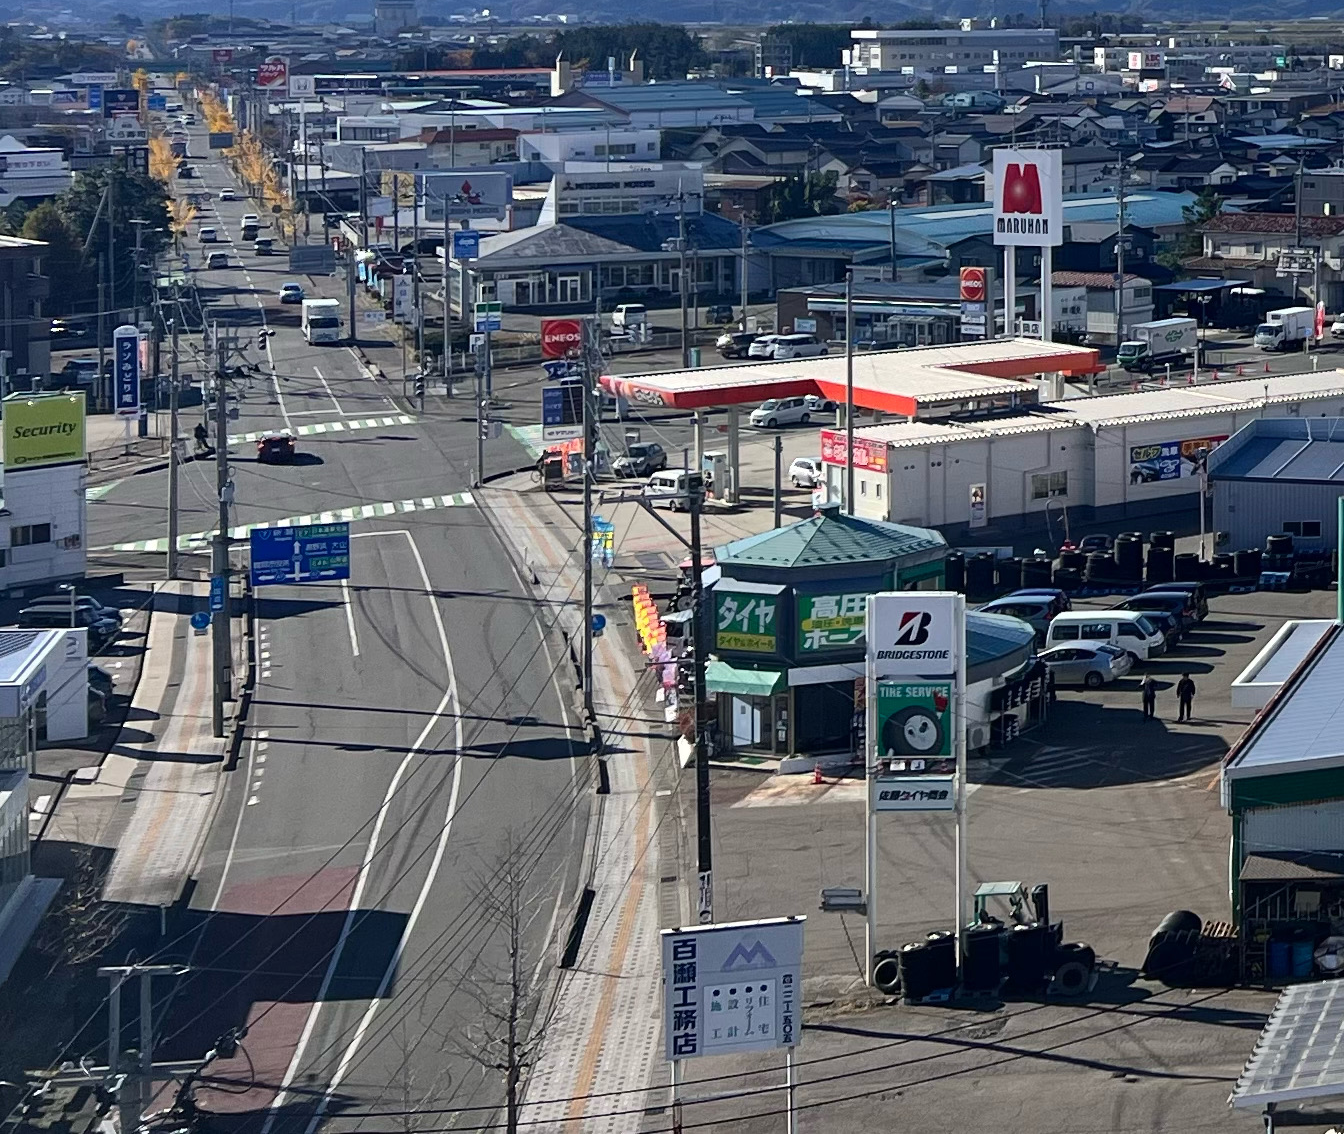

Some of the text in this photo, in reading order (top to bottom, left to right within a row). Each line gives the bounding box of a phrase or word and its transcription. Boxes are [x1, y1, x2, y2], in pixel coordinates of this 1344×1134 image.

[996, 217, 1049, 234] MARUHAN
[544, 333, 581, 343] ENEOS
[12, 422, 77, 439] Security
[810, 593, 868, 619] 高圧
[718, 597, 776, 633] タイヤ
[877, 650, 949, 659] BRIDGESTONE
[880, 686, 948, 698] TIRE SERVICE
[759, 996, 770, 1034] 住宅
